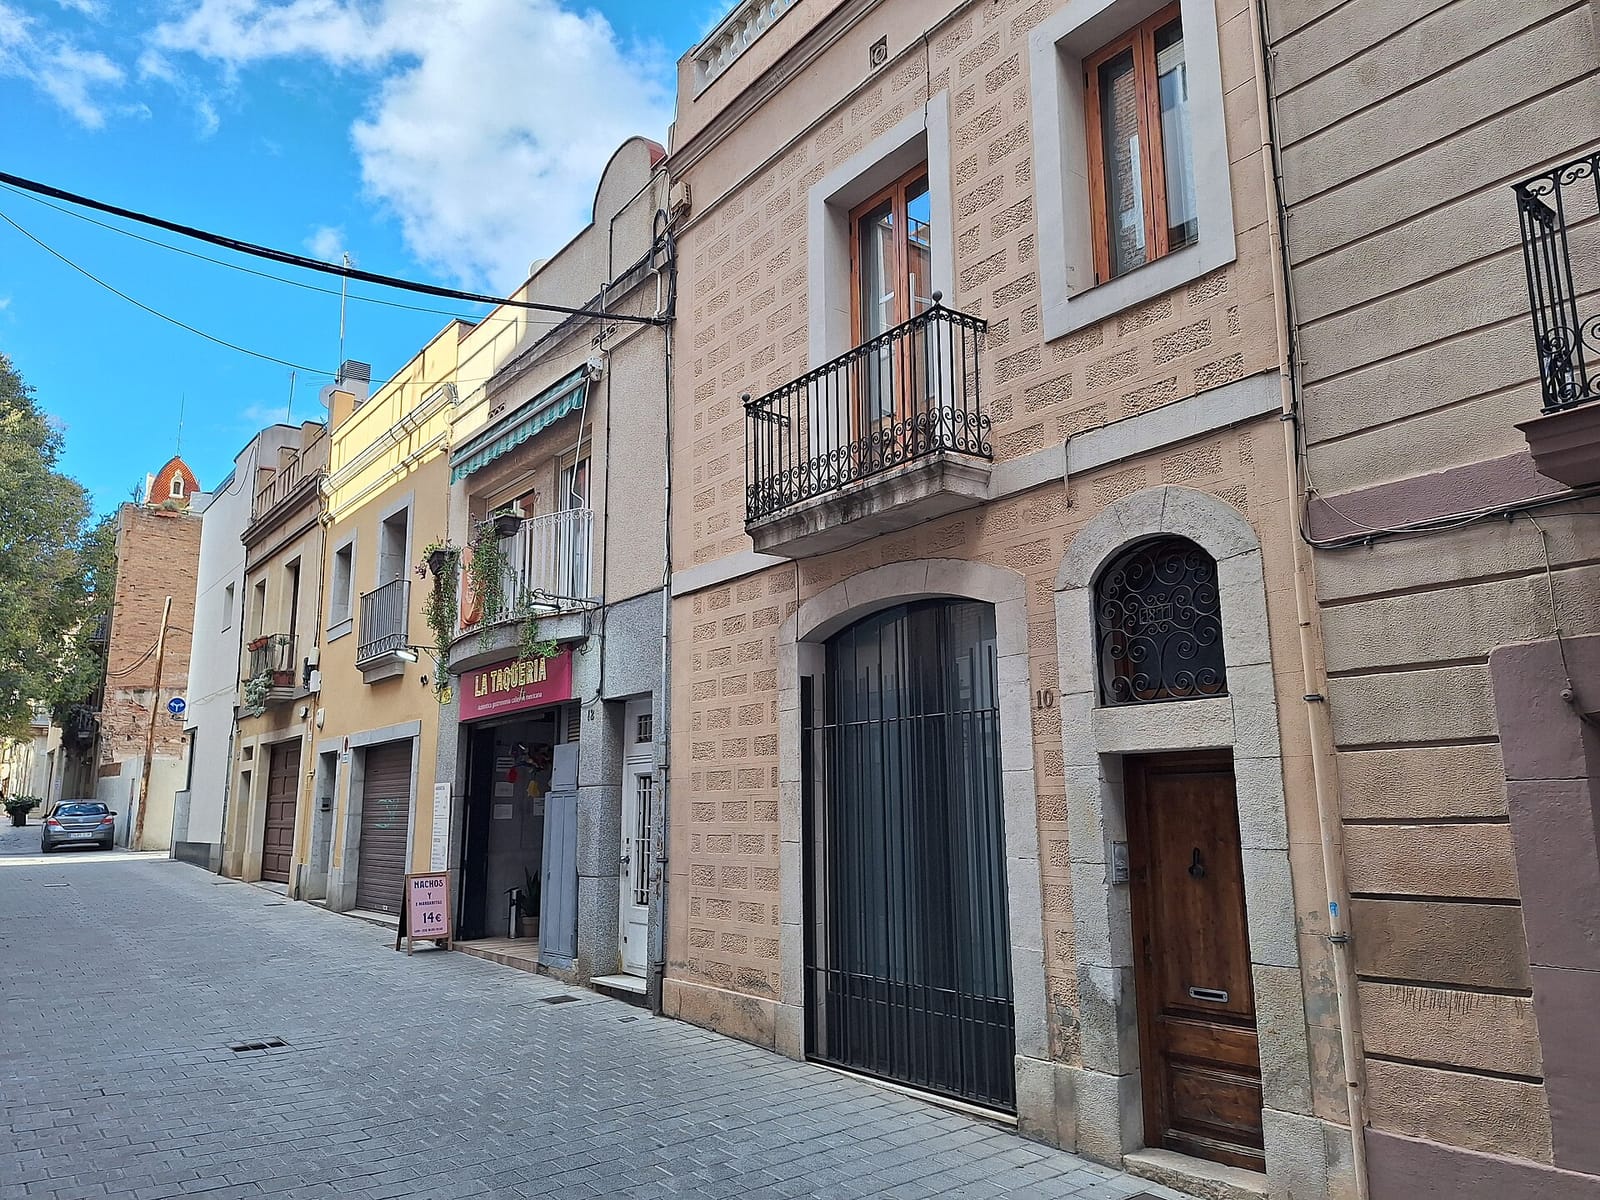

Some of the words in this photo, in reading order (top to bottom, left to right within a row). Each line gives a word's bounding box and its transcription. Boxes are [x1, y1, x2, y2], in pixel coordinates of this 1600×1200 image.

[474, 673, 488, 697] LA
[1036, 689, 1054, 709] 10
[414, 879, 444, 889] NACHOS
[427, 892, 432, 900] Y
[422, 911, 442, 924] 14€
